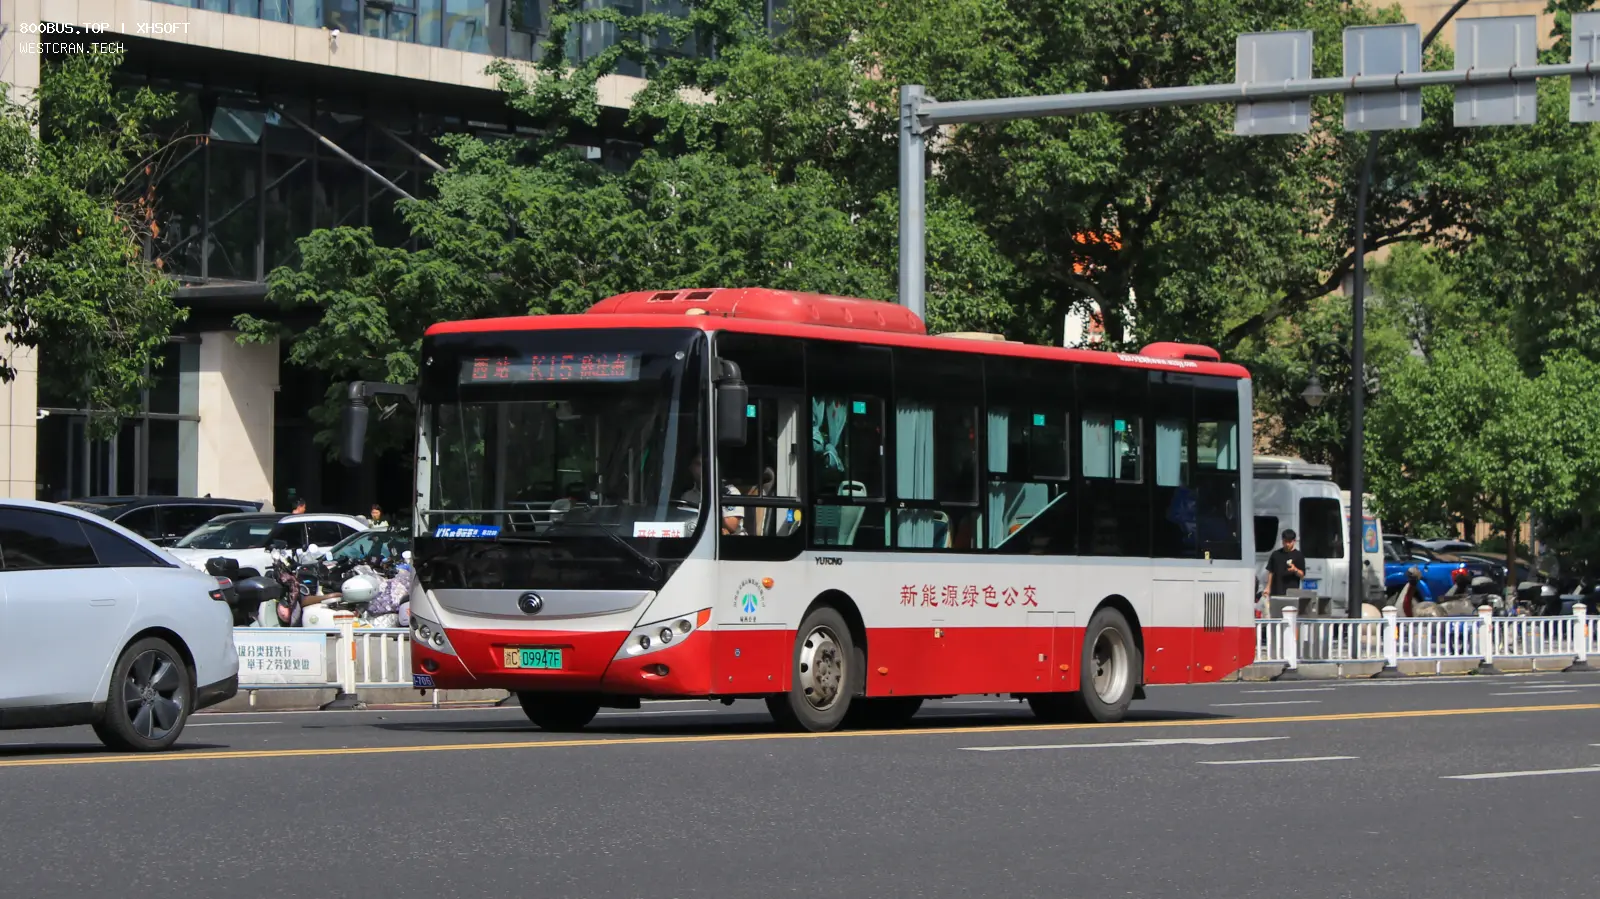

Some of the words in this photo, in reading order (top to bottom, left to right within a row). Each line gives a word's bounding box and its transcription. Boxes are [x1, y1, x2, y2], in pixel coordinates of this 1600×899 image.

[528, 355, 574, 381] K15
[814, 556, 843, 566] YUTONG
[900, 584, 1038, 608] 新能源绿色公交
